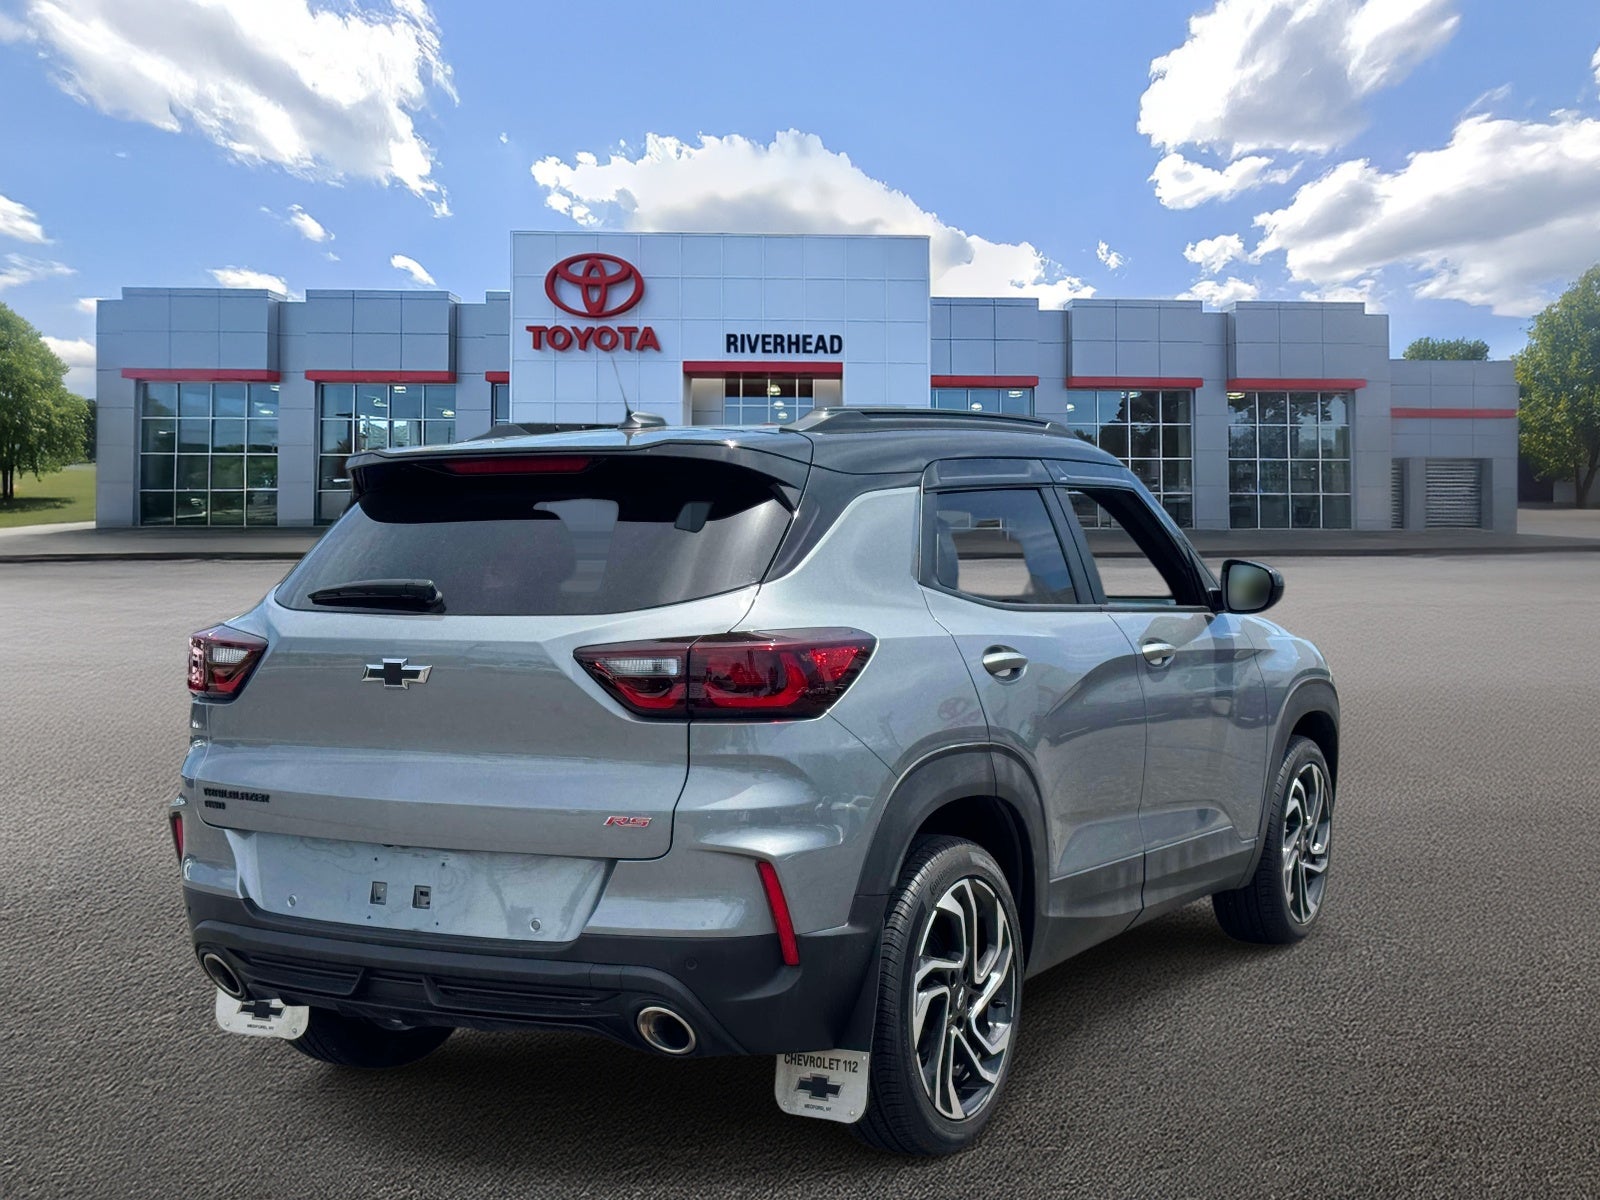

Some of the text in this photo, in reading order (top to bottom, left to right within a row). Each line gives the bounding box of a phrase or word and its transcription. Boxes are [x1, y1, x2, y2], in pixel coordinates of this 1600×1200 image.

[526, 326, 661, 351] TOYOTA
[727, 333, 843, 354] RIVERHEAD
[603, 815, 652, 827] RS
[784, 1054, 858, 1073] CHEVROLET 112
